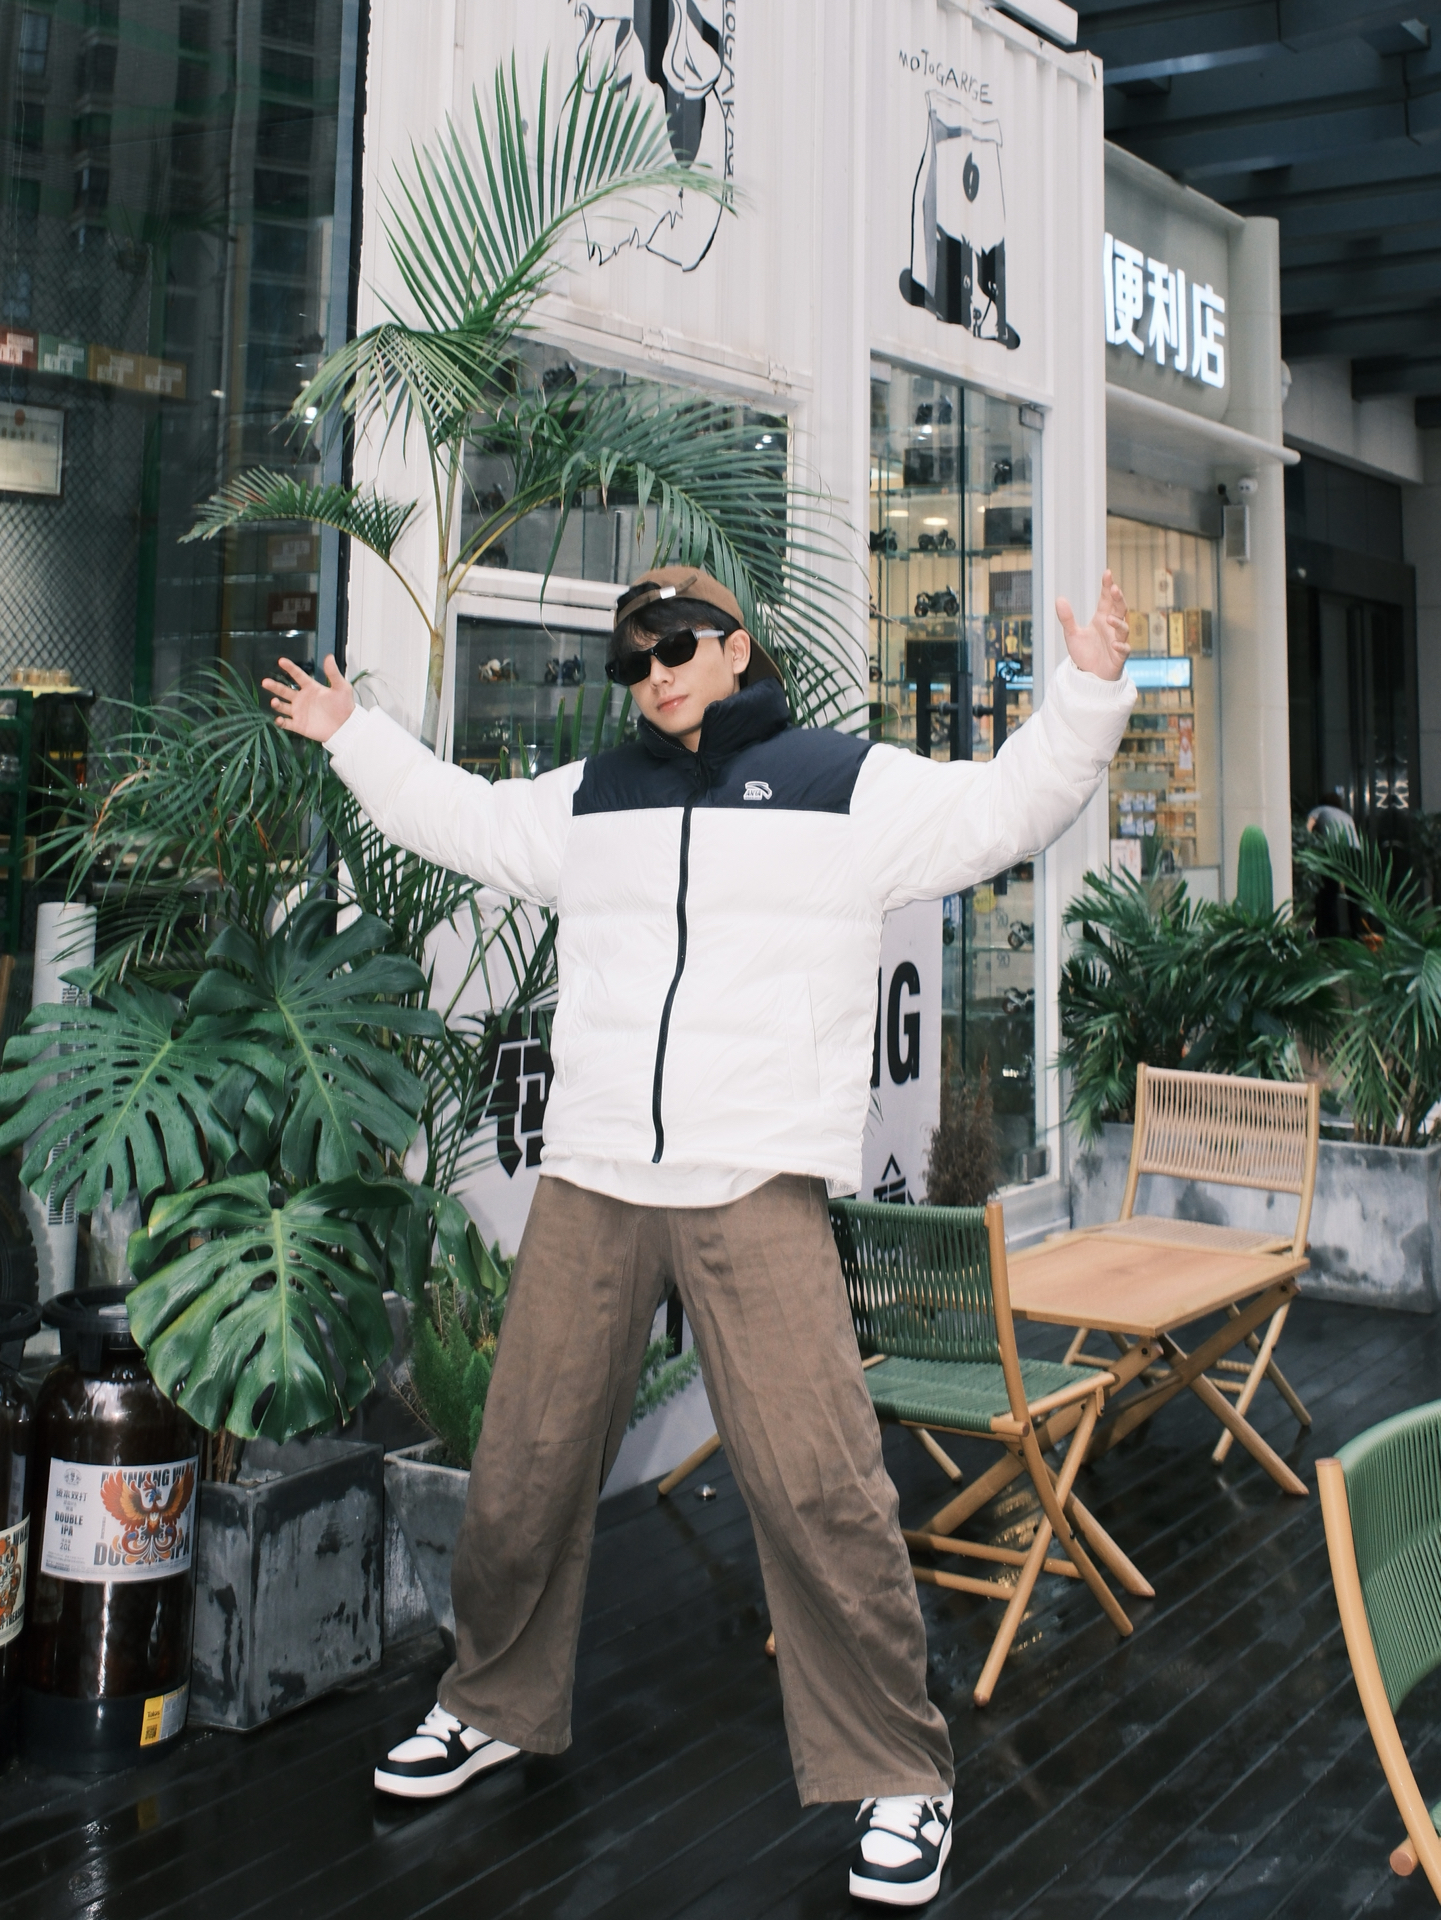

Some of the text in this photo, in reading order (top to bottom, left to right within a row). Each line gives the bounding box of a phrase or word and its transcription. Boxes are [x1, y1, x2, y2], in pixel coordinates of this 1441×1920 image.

[1103, 232, 1226, 389] 便利店
[54, 1510, 84, 1525] DOUBLE
[60, 1524, 74, 1536] IPA
